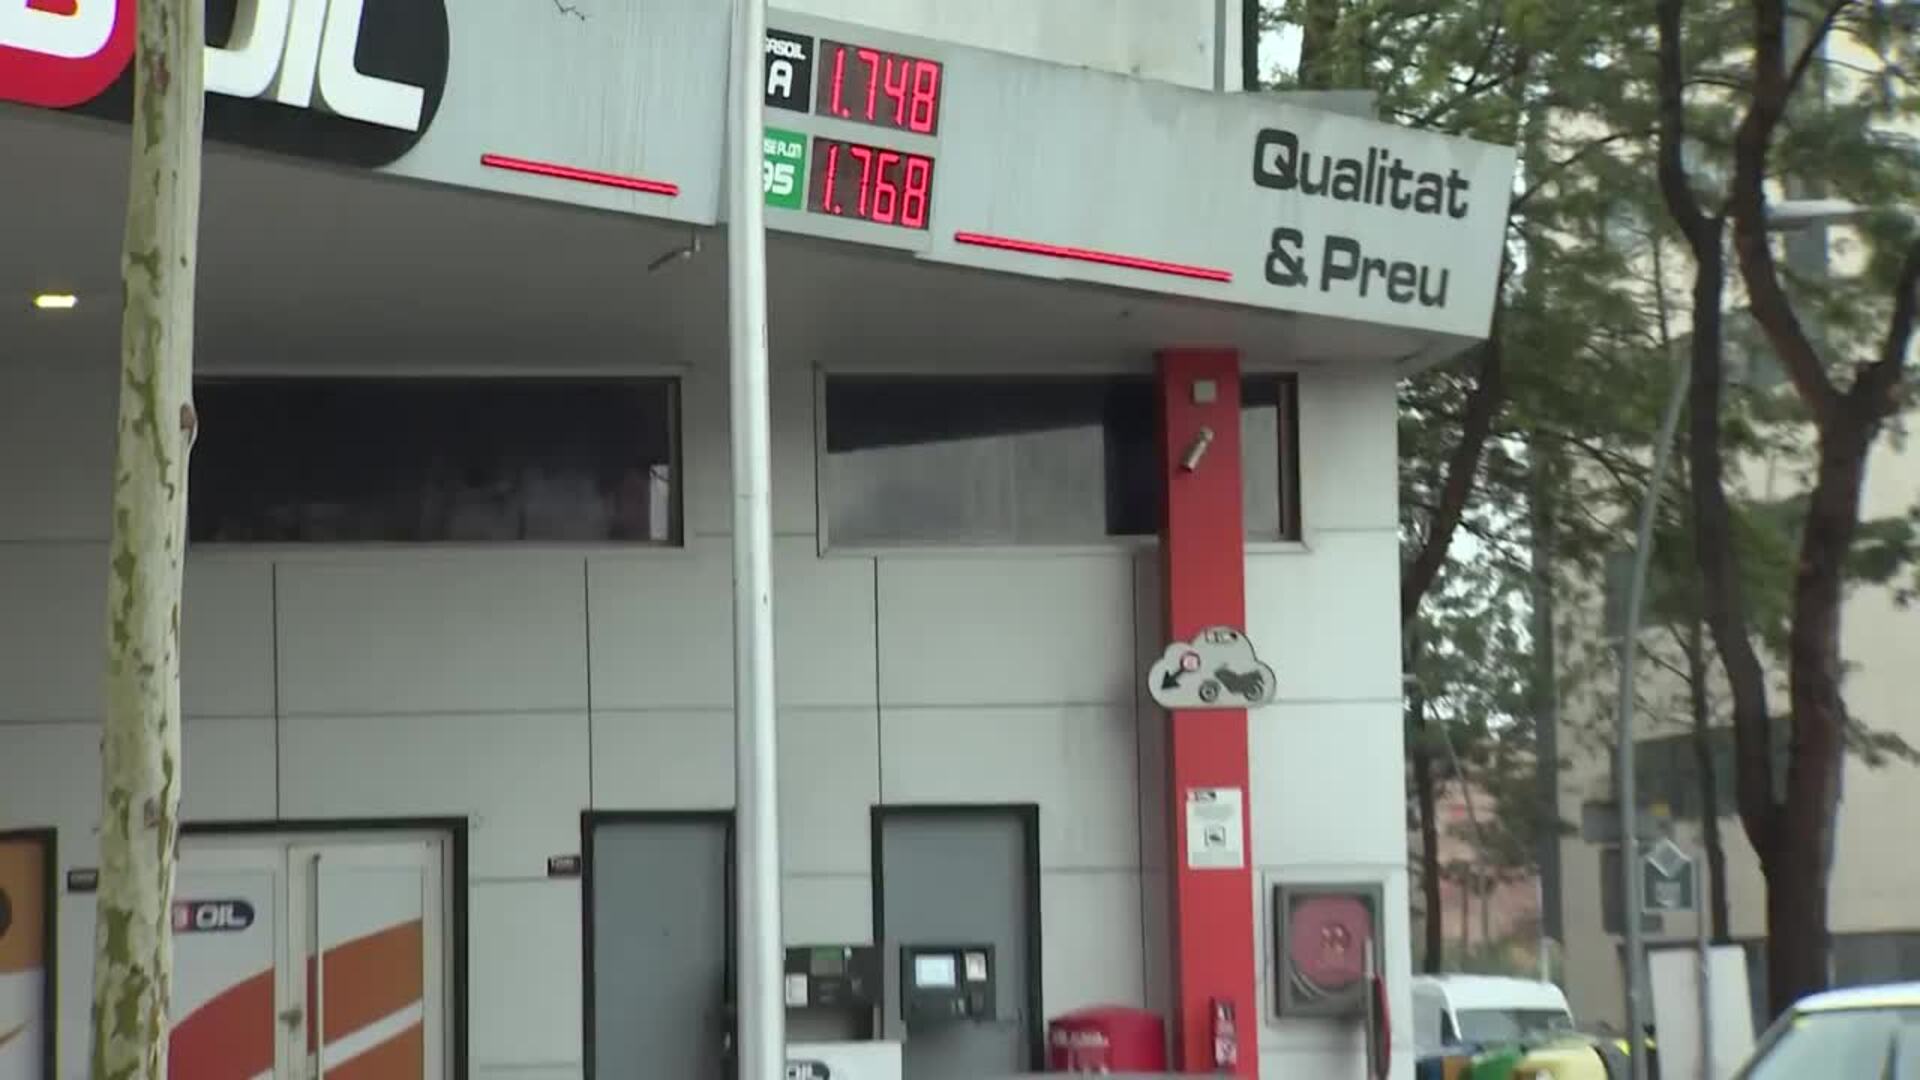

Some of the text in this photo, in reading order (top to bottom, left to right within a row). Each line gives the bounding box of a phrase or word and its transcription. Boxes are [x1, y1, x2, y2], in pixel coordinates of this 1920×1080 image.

[765, 37, 806, 60] ASOIL
[767, 60, 793, 98] A
[831, 47, 939, 133] 1.748
[822, 144, 930, 228] 1.768
[1253, 128, 1470, 219] Qualitat
[1265, 227, 1449, 308] & Preu
[196, 903, 247, 929] OIL
